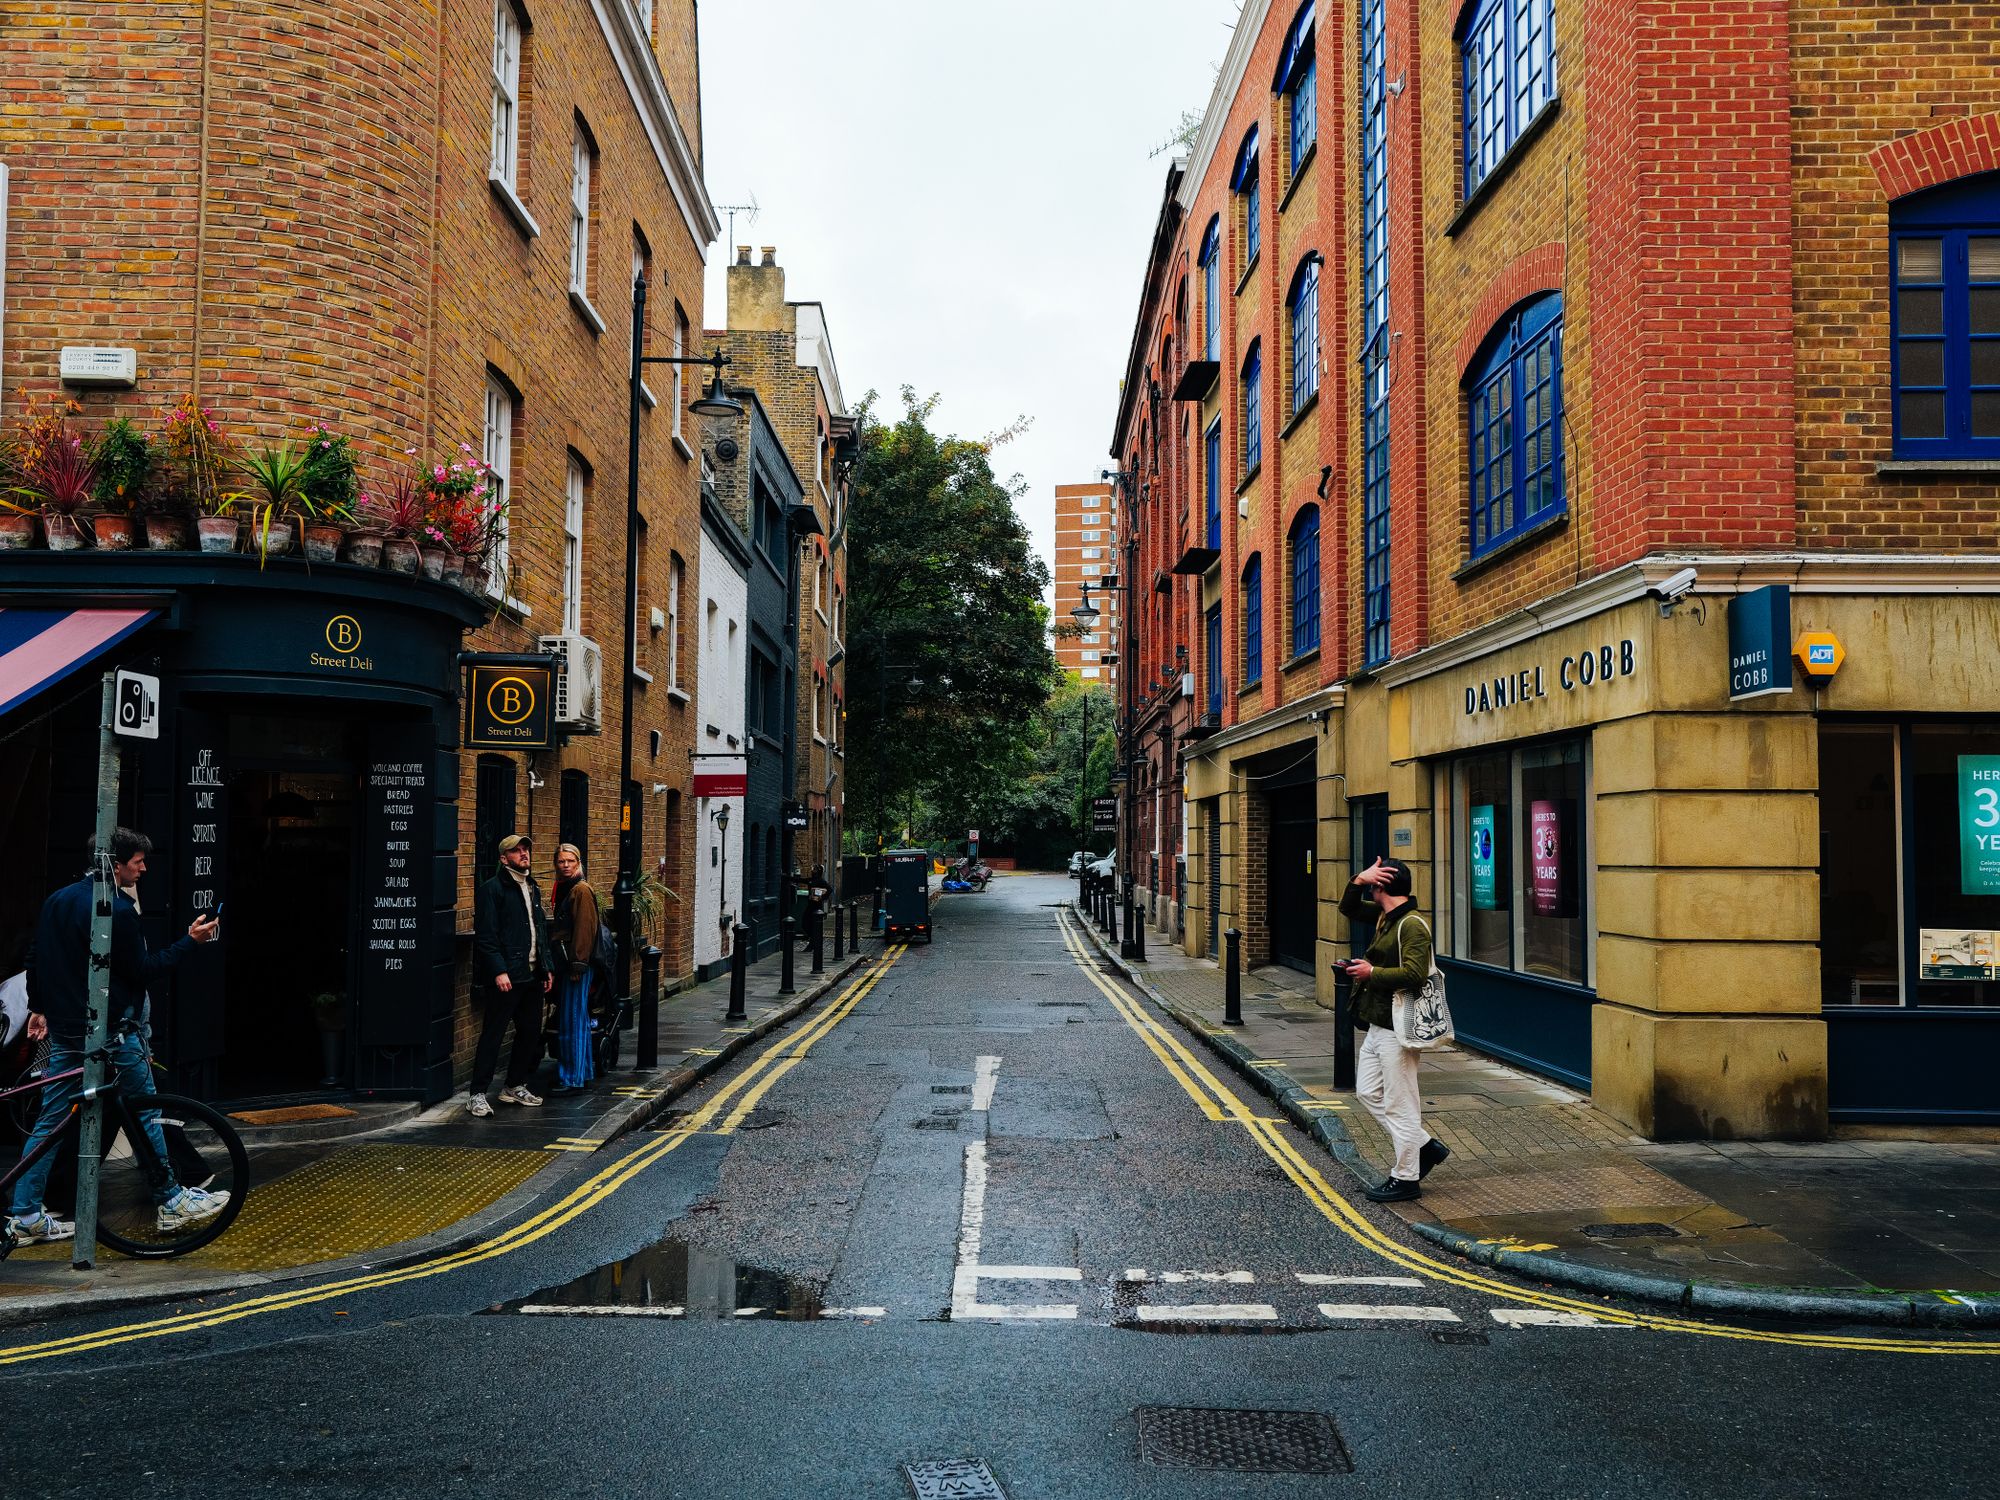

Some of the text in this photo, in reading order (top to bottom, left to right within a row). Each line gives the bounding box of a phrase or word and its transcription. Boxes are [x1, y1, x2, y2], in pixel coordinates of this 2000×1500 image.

[337, 622, 352, 644] B
[1809, 648, 1833, 660] ADT
[310, 652, 373, 670] Street Deli
[1733, 649, 1768, 690] DANIEL COBB
[1465, 639, 1636, 715] DANIEL COBB
[501, 687, 521, 713] B
[487, 726, 532, 737] Street Deli
[198, 749, 212, 767] OFF
[372, 763, 423, 773] VOLCANO COFFEE
[370, 775, 425, 786] SPECIALITY TREATS
[1973, 770, 2000, 781] HER
[195, 791, 215, 809] WINE
[386, 790, 410, 800] BREAD
[383, 804, 414, 815] PASTRIES
[1974, 787, 2000, 828] 3
[390, 821, 408, 831] EGGS
[192, 823, 217, 843] SPIRITS
[386, 841, 410, 851] BUTTER
[1975, 834, 2000, 851] YE
[194, 856, 212, 876] BEER
[388, 857, 406, 868] SOUP
[1473, 864, 1491, 877] YEARS
[1536, 866, 1557, 880] YEARS
[384, 876, 410, 888] SALADS
[192, 889, 214, 909] CIDER
[373, 896, 417, 908] SANDWICHES
[371, 917, 417, 930] SCOTCH EGGS
[368, 939, 417, 950] SAUSAGE ROLLS
[385, 958, 403, 970] PIES
